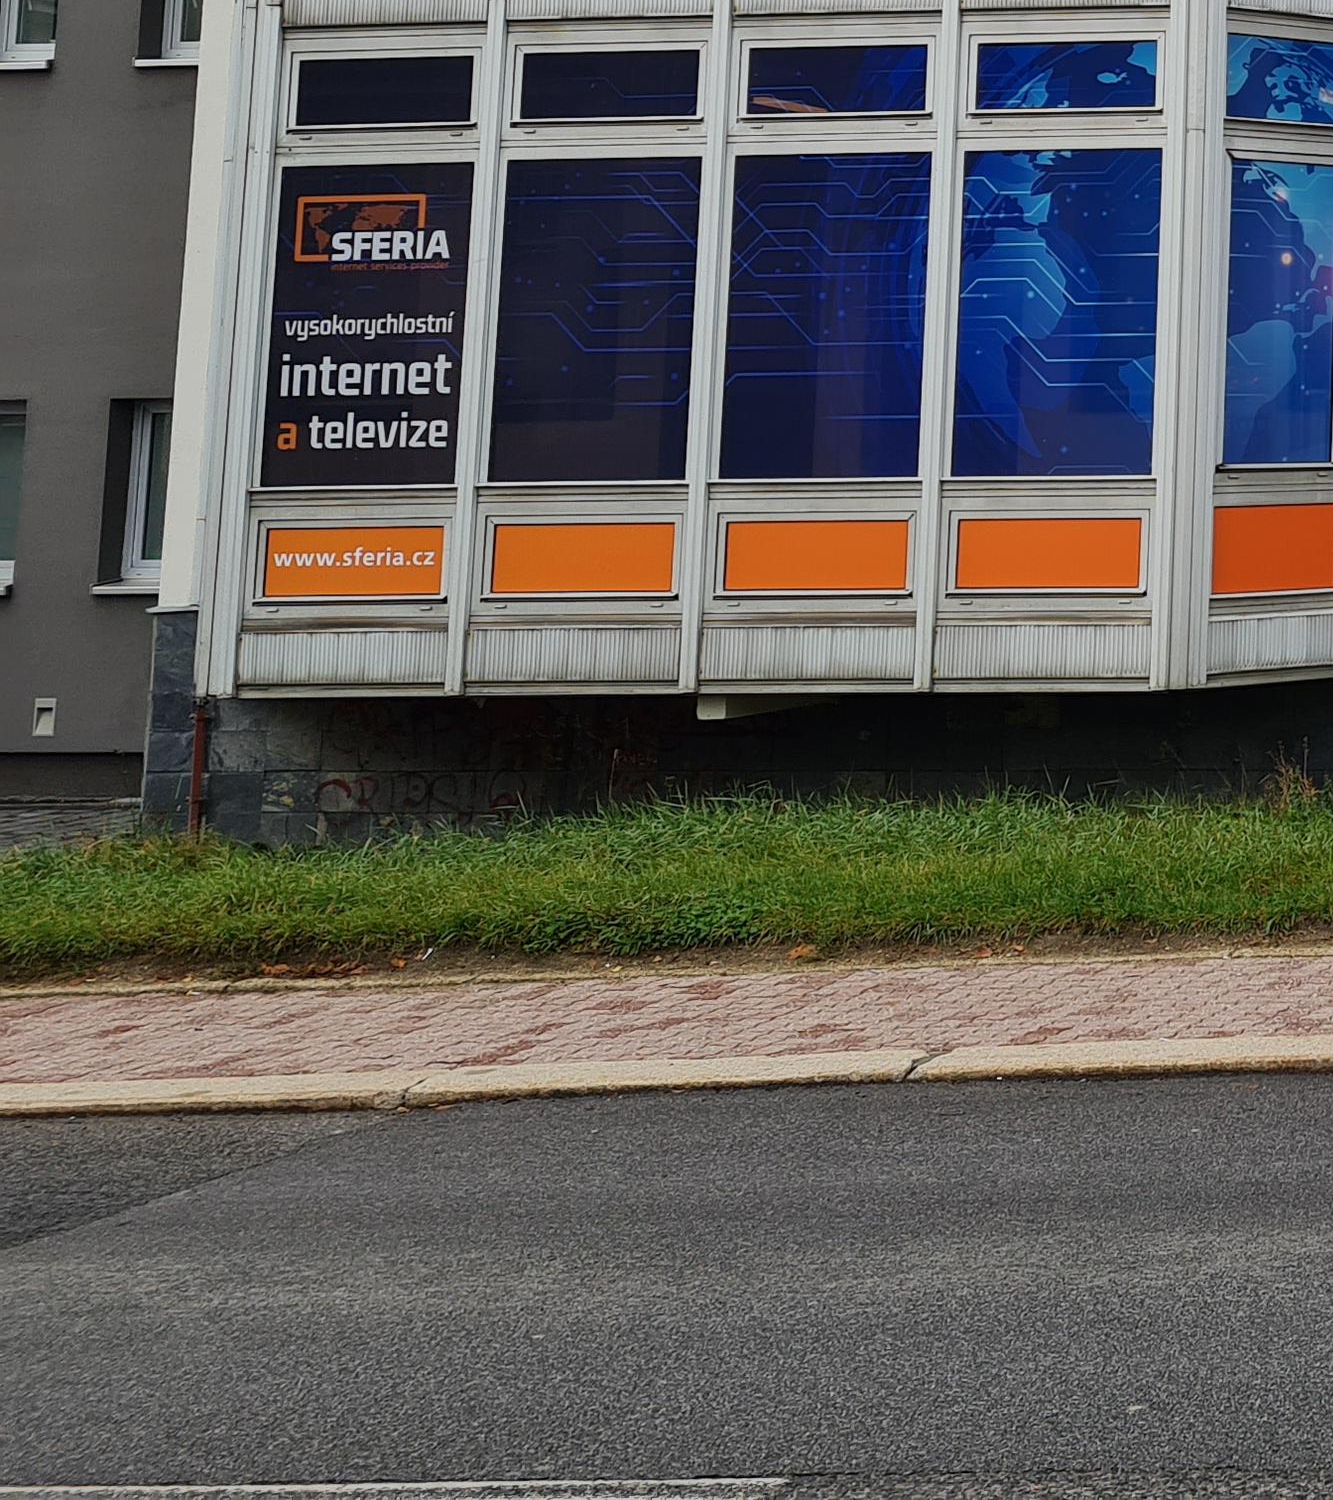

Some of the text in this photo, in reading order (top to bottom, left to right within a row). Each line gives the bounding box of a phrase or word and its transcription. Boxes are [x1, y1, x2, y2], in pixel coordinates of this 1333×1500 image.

[330, 230, 450, 262] SFERIA
[284, 311, 456, 342] vysokorychlostní
[279, 353, 453, 397] internet
[276, 411, 449, 451] a televize
[273, 546, 436, 568] www.sferia.cz
